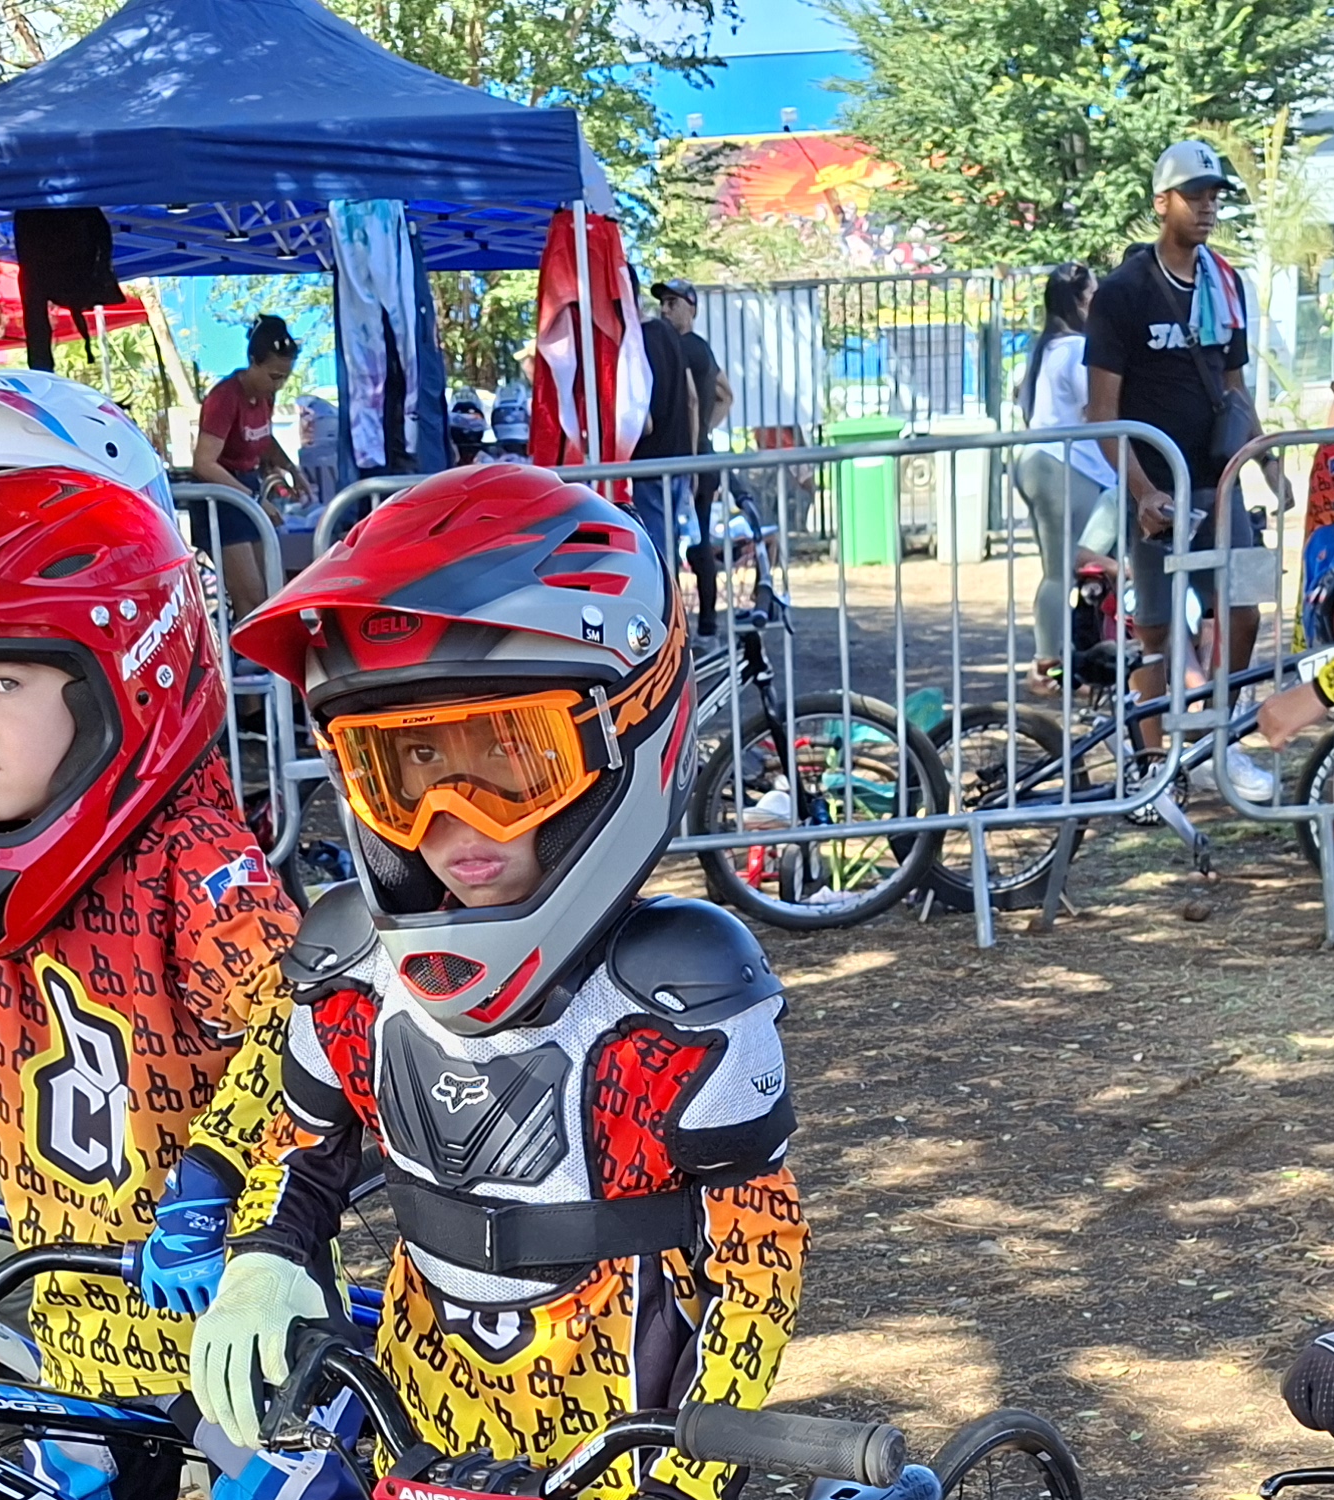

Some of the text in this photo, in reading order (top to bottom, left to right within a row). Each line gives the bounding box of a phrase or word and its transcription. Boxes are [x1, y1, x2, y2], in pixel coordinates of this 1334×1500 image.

[368, 616, 412, 633] BELL
[585, 627, 600, 642] SM
[544, 1439, 606, 1495] EDGE
